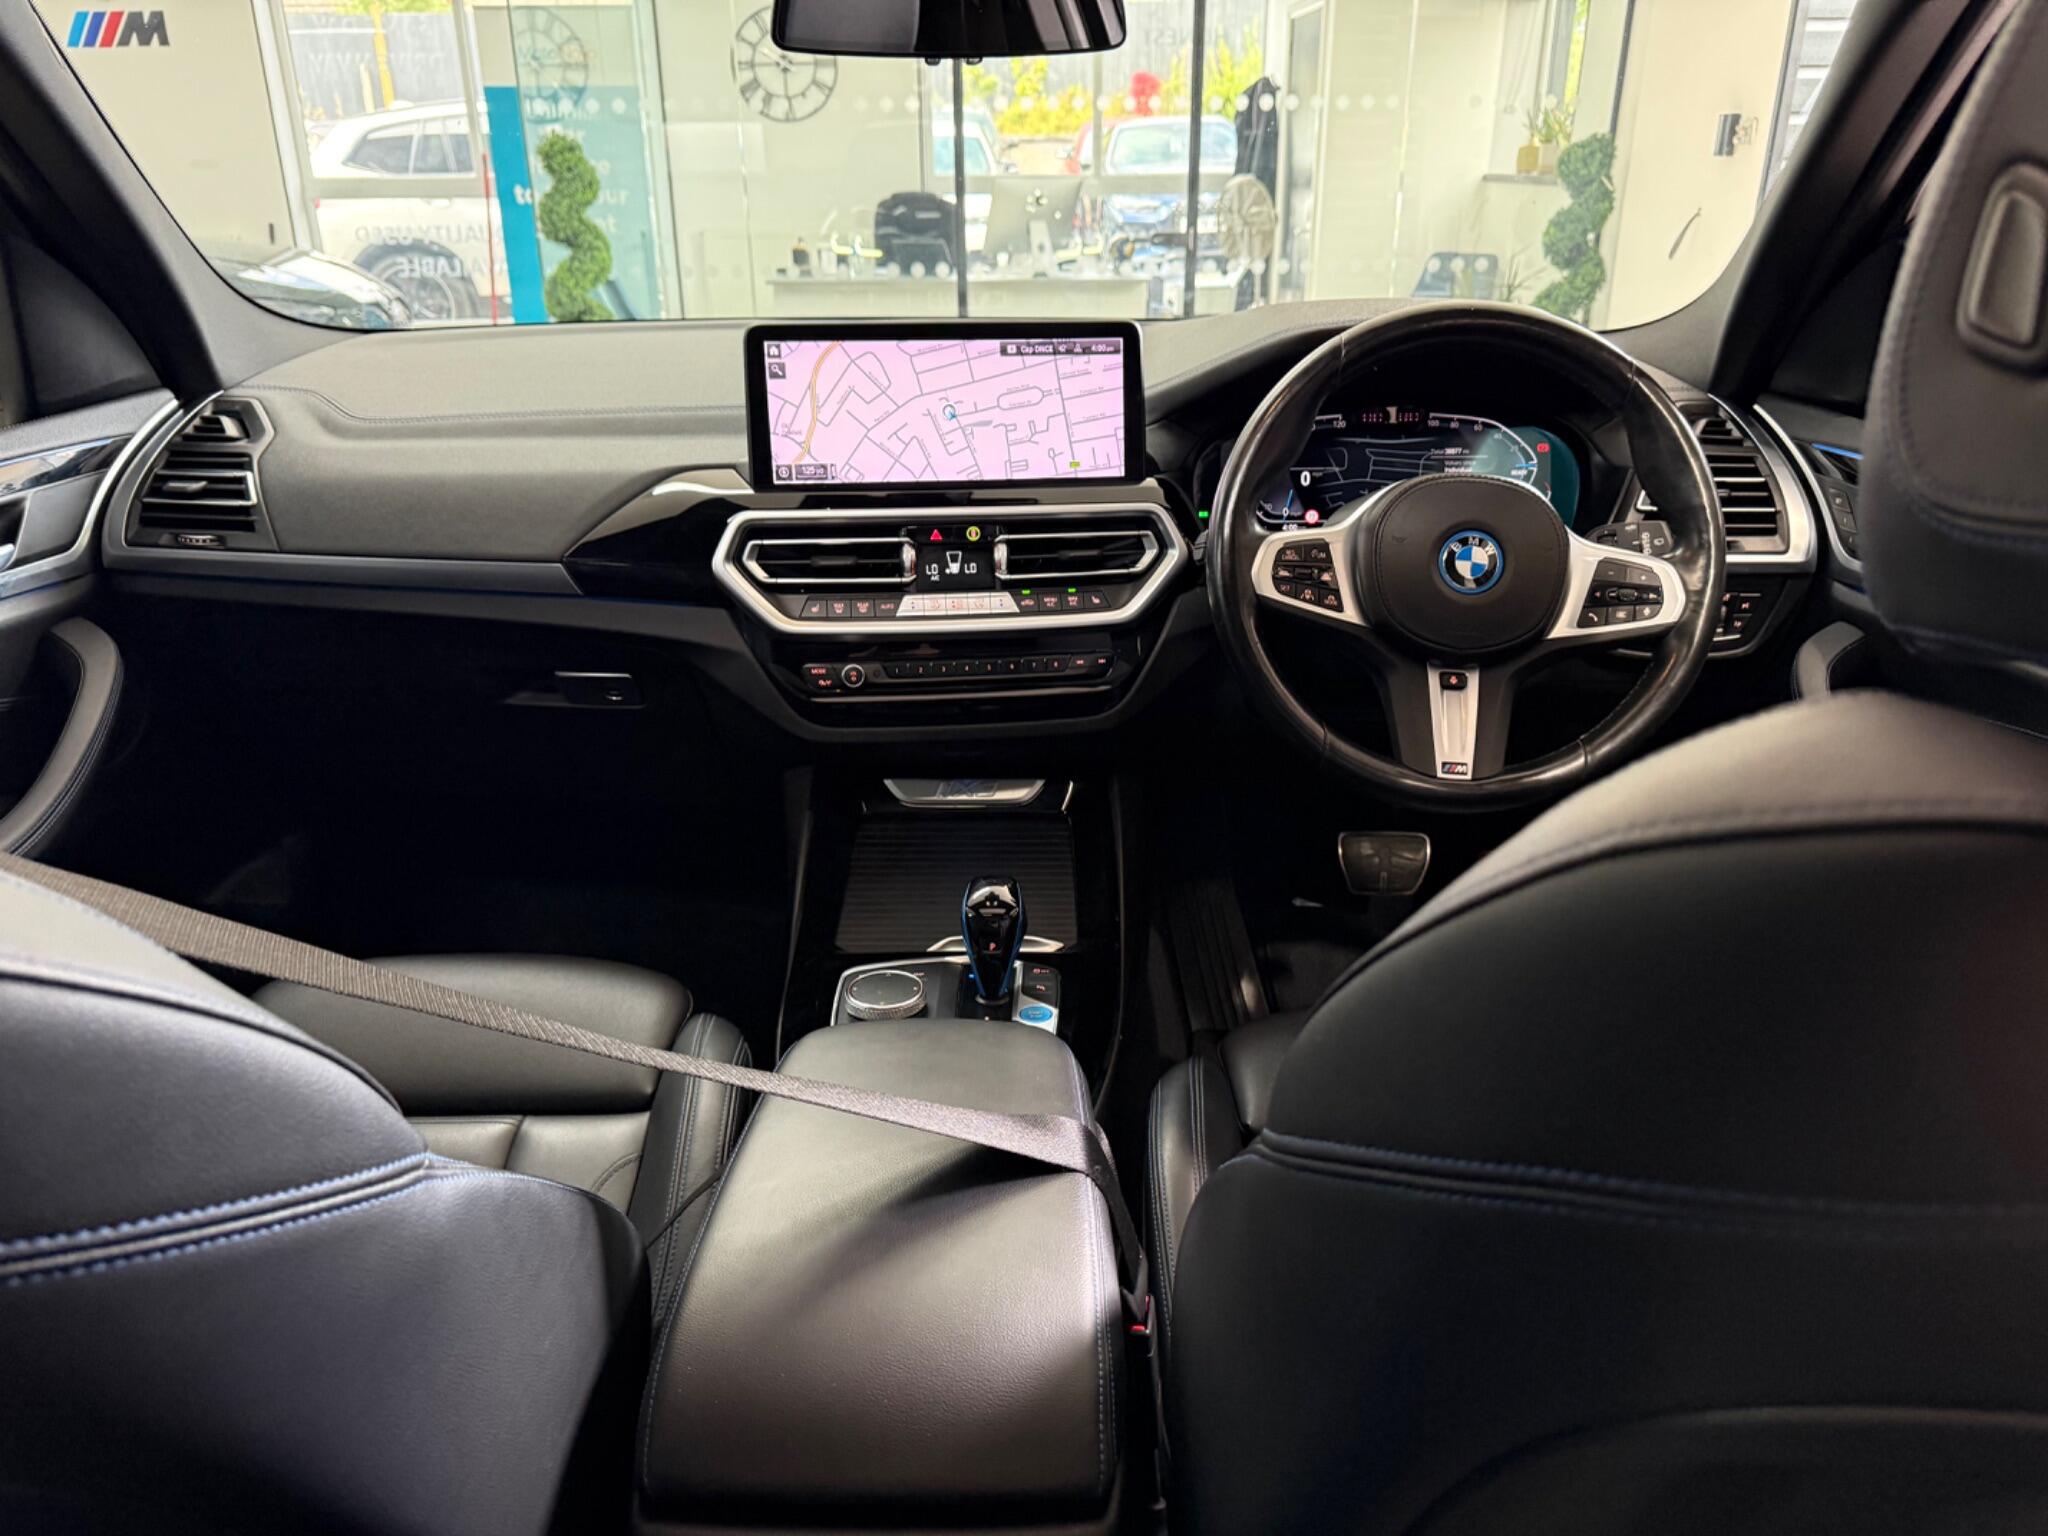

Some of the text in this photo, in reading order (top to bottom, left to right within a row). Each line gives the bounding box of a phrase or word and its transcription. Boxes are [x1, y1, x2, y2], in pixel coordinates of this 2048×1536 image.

[1300, 470, 1311, 487] 0
[1450, 536, 1496, 557] BMW
[926, 563, 939, 575] LO
[964, 562, 977, 574] LO
